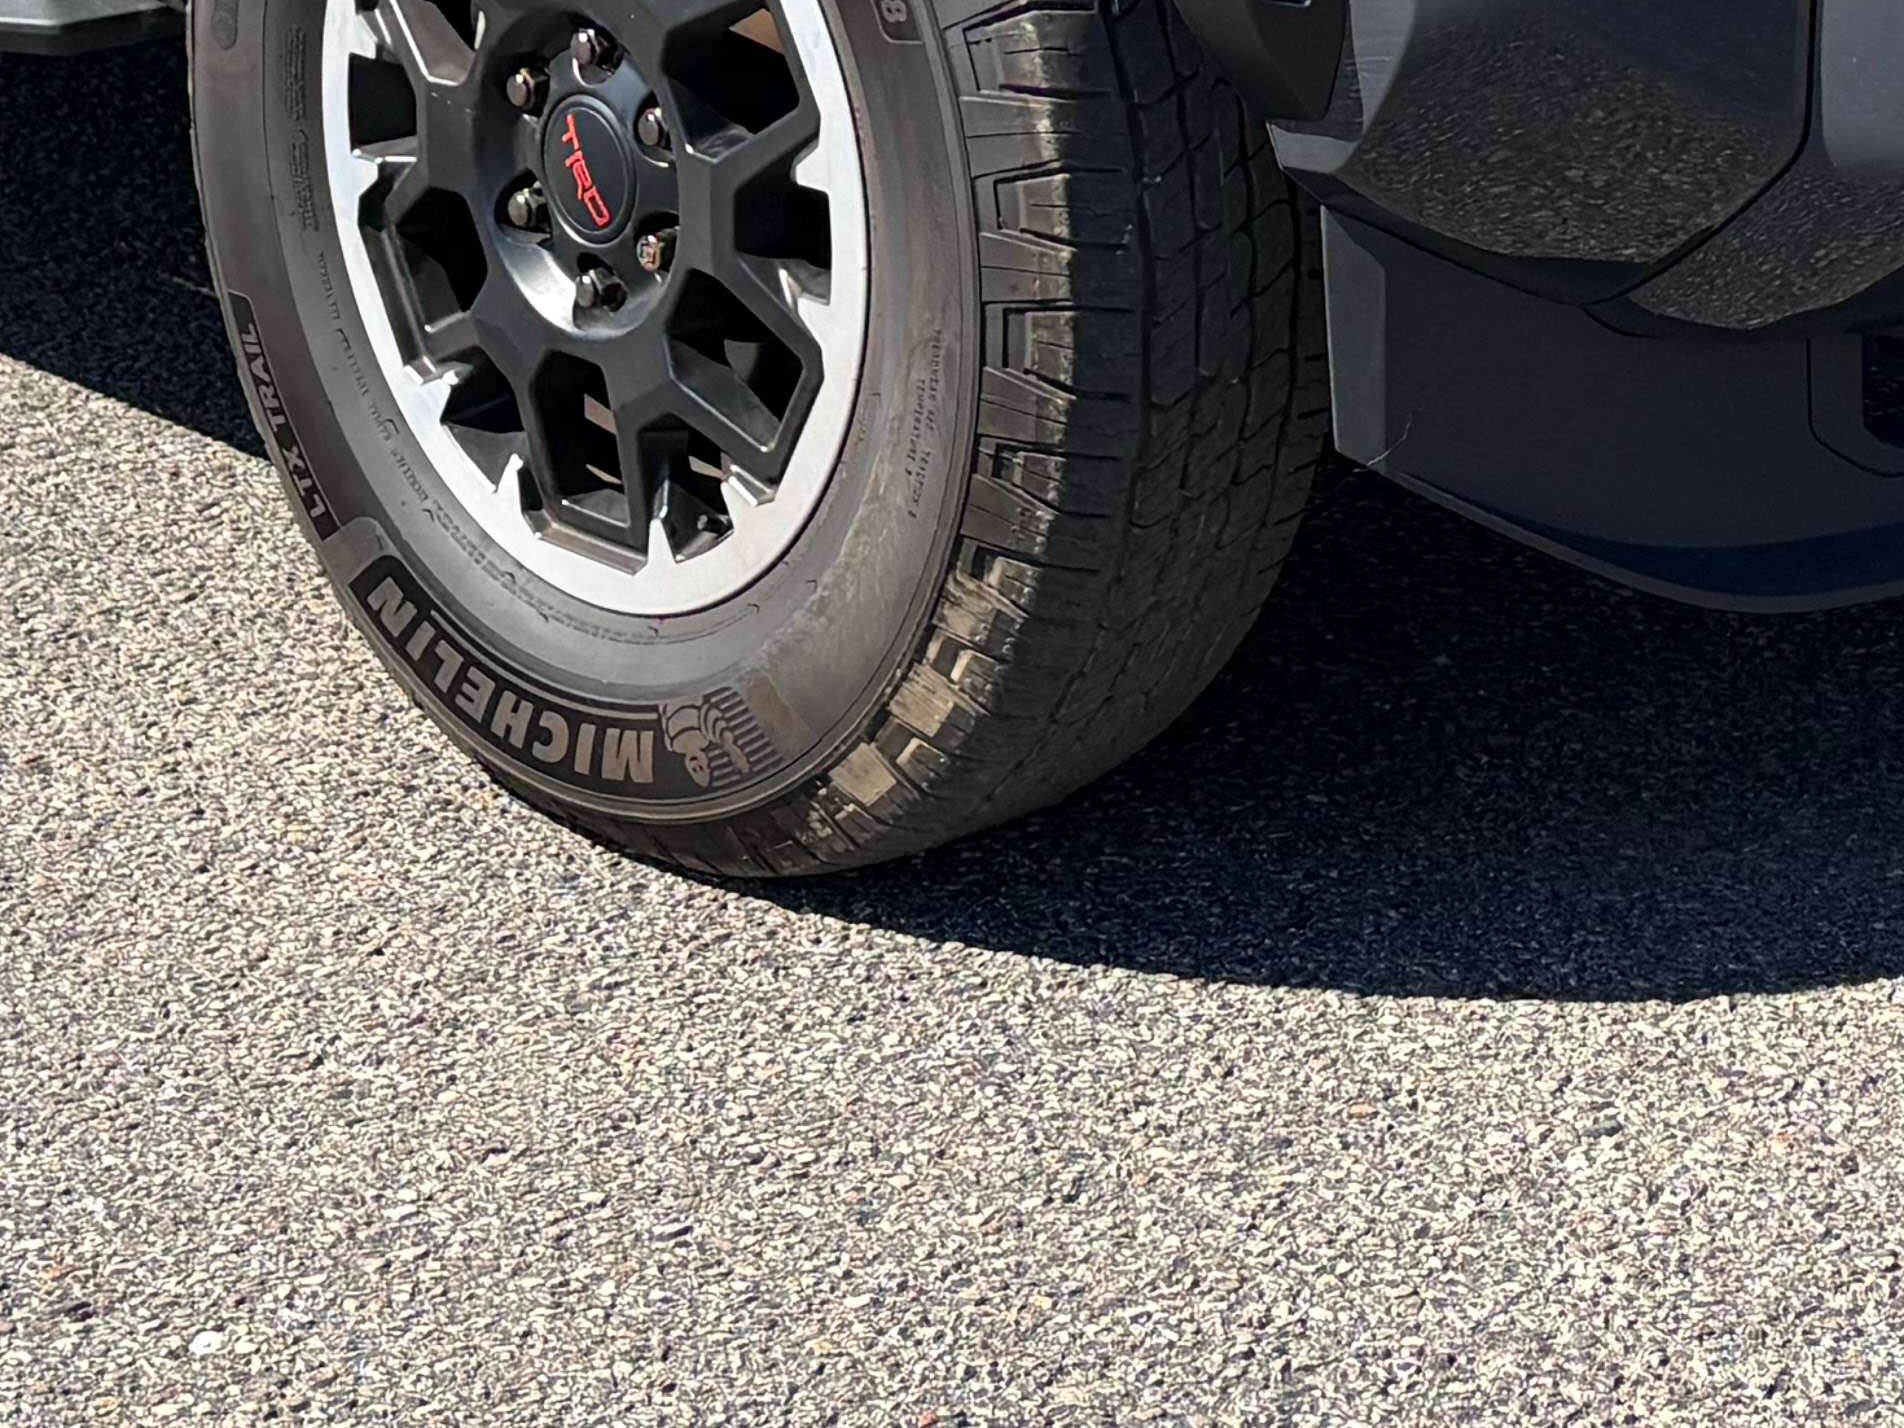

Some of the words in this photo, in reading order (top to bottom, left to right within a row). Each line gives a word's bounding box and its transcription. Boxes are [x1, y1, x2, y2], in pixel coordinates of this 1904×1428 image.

[561, 113, 612, 228] TRD
[240, 322, 288, 433] TRAIL
[280, 446, 326, 519] LTX
[366, 571, 655, 785] MICHELIN
